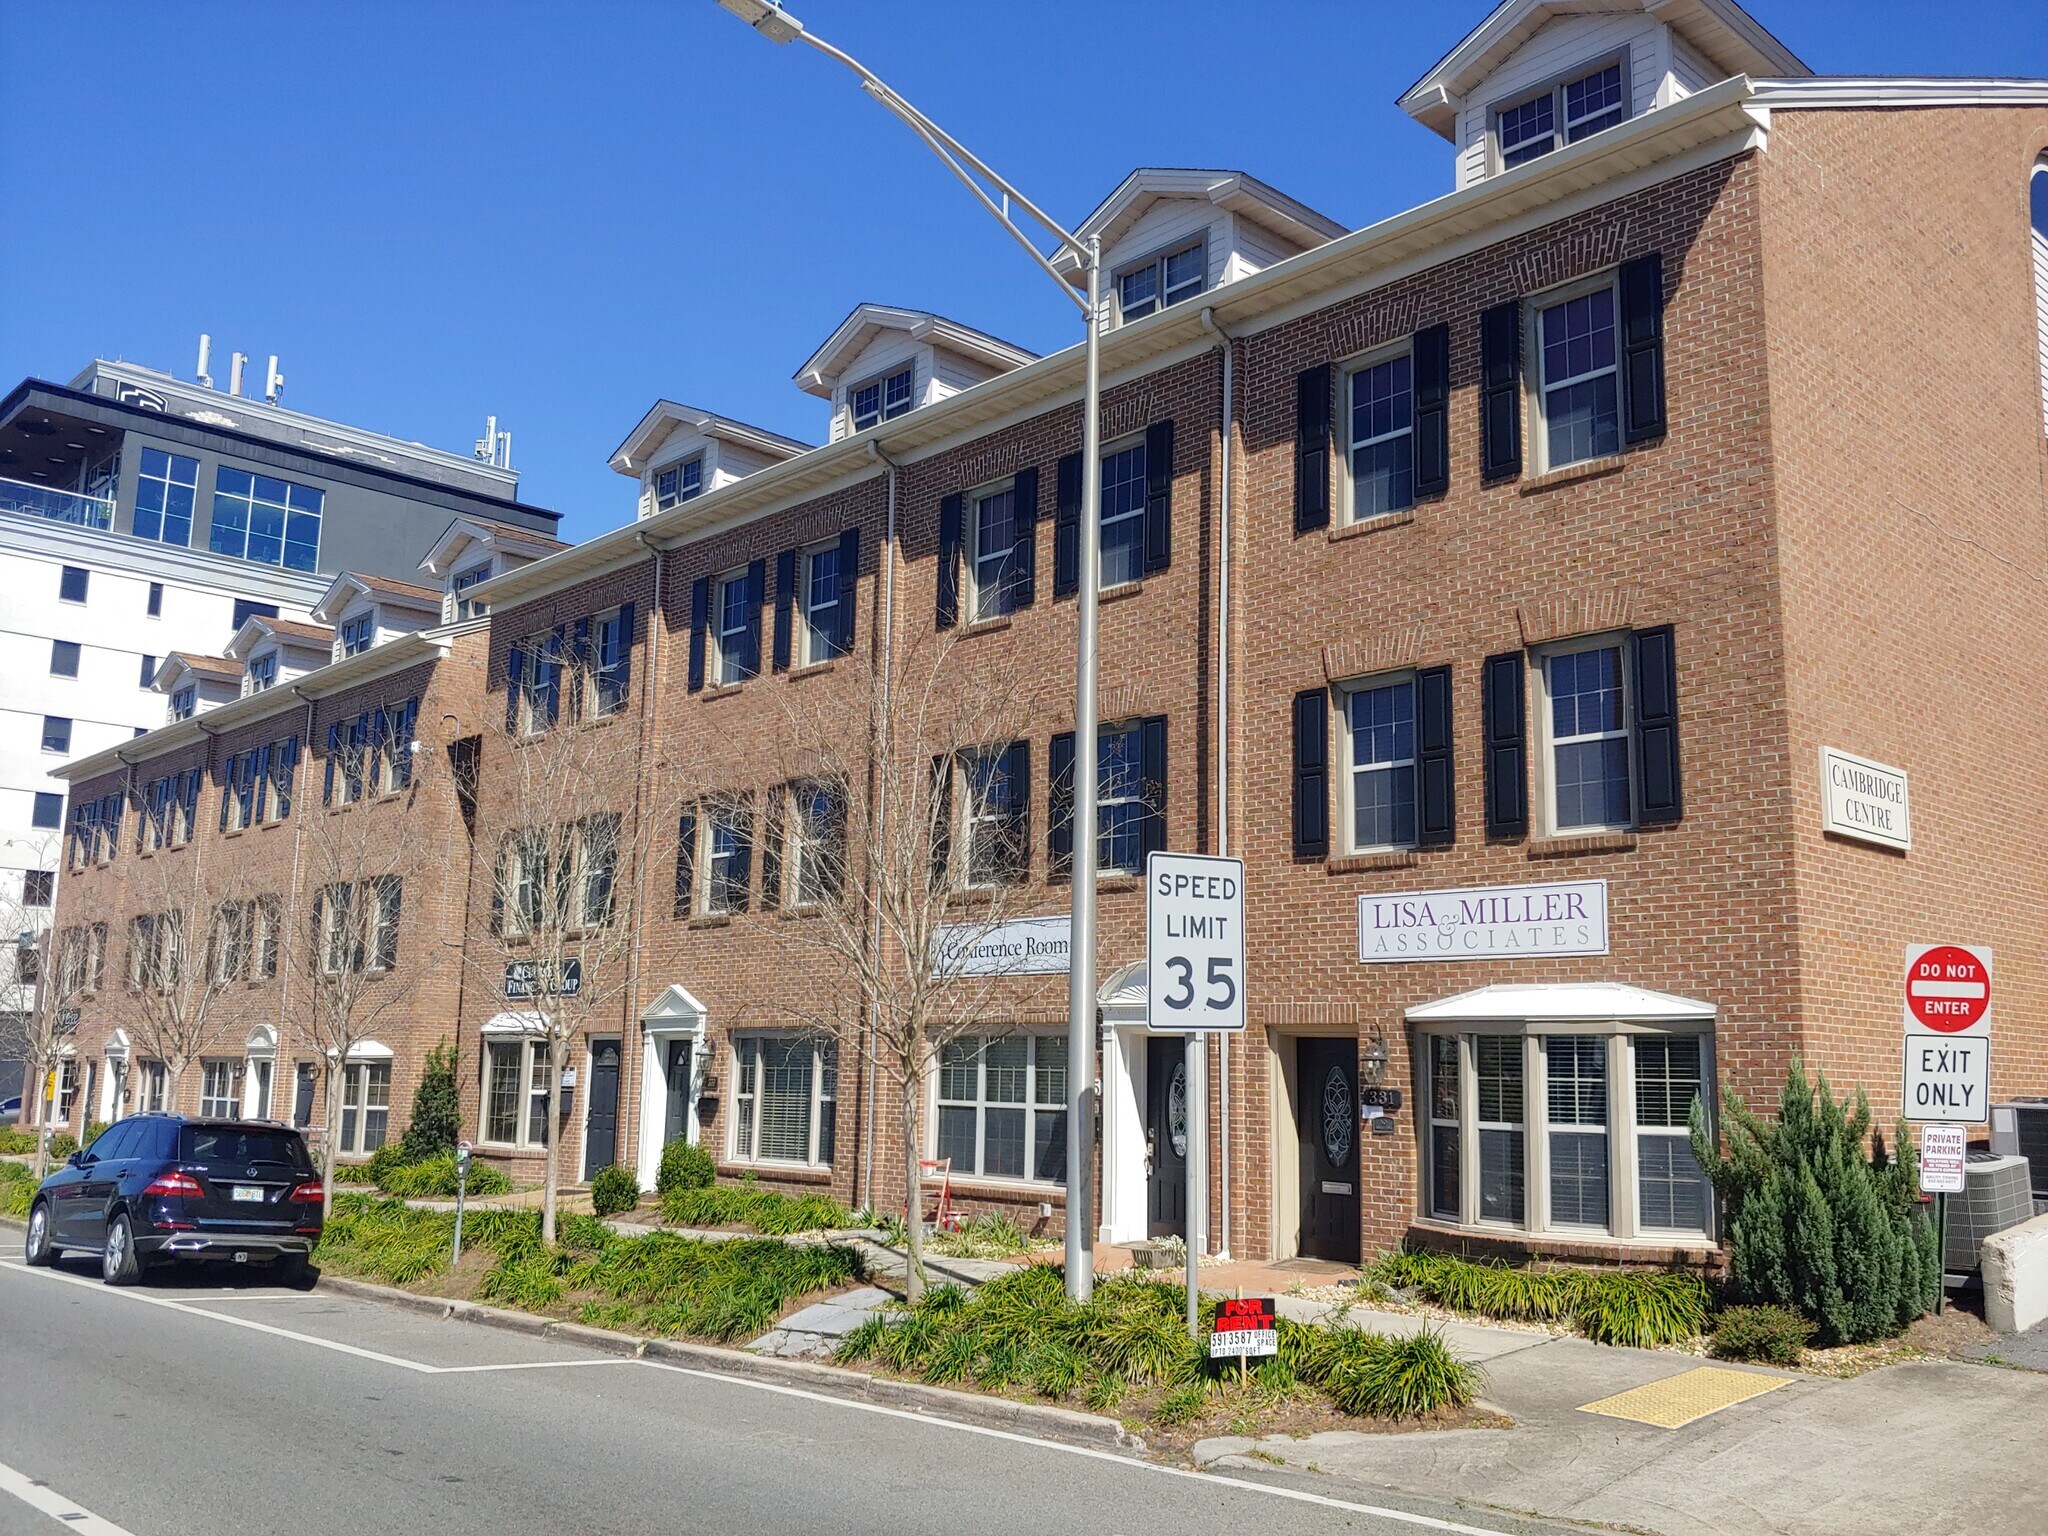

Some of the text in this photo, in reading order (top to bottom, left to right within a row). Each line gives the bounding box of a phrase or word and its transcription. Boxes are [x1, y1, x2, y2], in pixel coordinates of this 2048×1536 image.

[1832, 764, 1902, 804] CAMBRIDGE
[1845, 798, 1893, 831] CENTRE
[1158, 873, 1236, 900] SPEED
[1373, 901, 1437, 929] LISA
[1458, 892, 1589, 925] MILLER
[1167, 914, 1227, 940] LIMIT
[1026, 937, 1068, 956] Room
[1374, 925, 1589, 952] ASSOCIATES
[1920, 963, 1976, 979] DO NOT
[1163, 956, 1236, 1010] 35
[1924, 1000, 1970, 1015] ENTER
[1922, 1049, 1971, 1074] EXIT
[1369, 1090, 1394, 1105] 331
[1916, 1082, 1975, 1107] ONLY
[1927, 1134, 1961, 1144] PRIVATE
[1926, 1145, 1961, 1155] PARKING
[1225, 1299, 1263, 1316] FOR
[1217, 1314, 1274, 1333] RENT
[1254, 1330, 1275, 1339] OFFICE
[1257, 1338, 1276, 1347] SPACE
